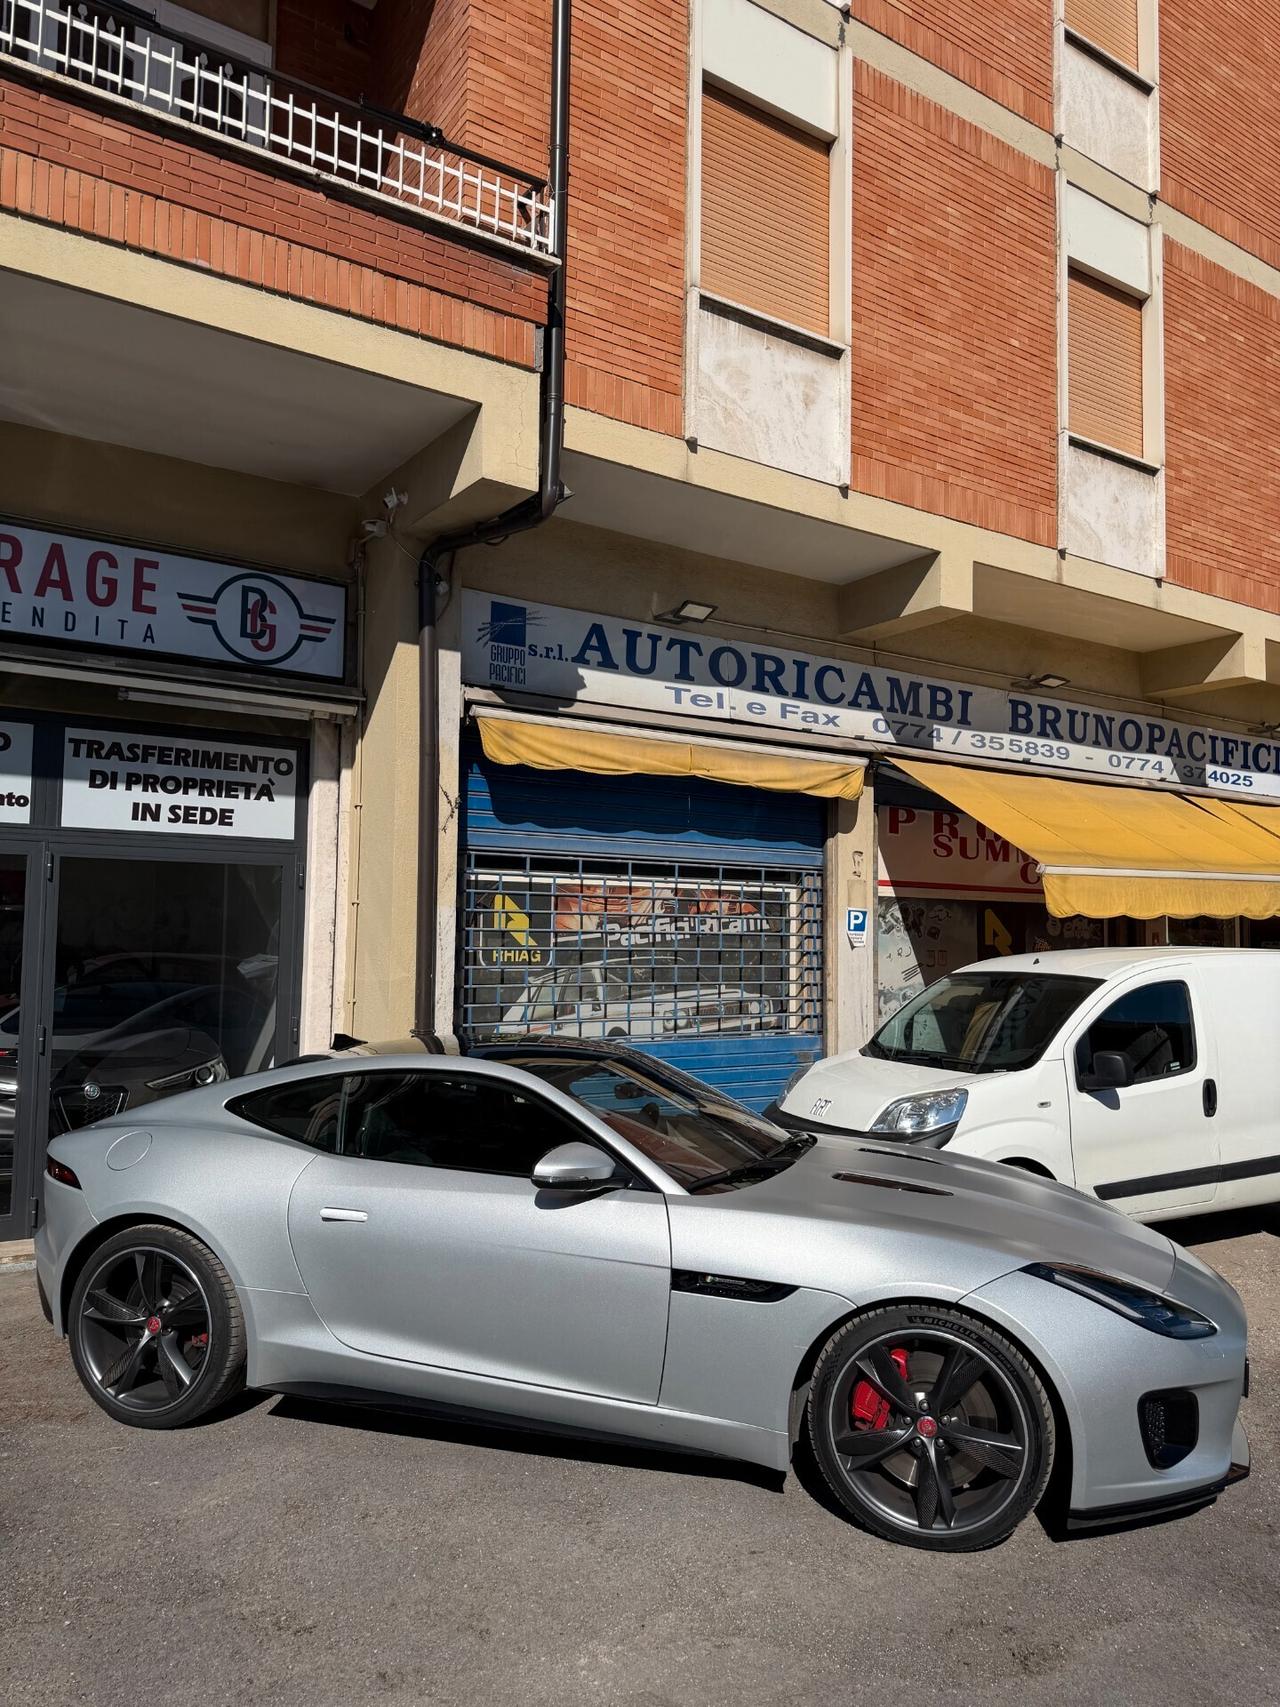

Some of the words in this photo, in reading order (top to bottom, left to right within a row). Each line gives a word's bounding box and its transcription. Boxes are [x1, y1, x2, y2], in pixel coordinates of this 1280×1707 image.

[490, 644, 526, 666] GRUPPO
[489, 663, 526, 685] PACIFICI
[528, 644, 569, 662] s.r.l.
[570, 622, 973, 726] AUTORICAMBI
[665, 685, 736, 711] Tel.
[747, 701, 767, 716] e
[780, 703, 841, 728] Fax
[68, 738, 294, 776] TRASFERIMENTO
[88, 769, 118, 790] DI
[125, 773, 275, 802] PROPRIETÀ
[131, 802, 162, 822] IN
[167, 804, 234, 827] SEDE
[849, 911, 864, 930] P
[923, 1317, 979, 1340] MICHELIN
